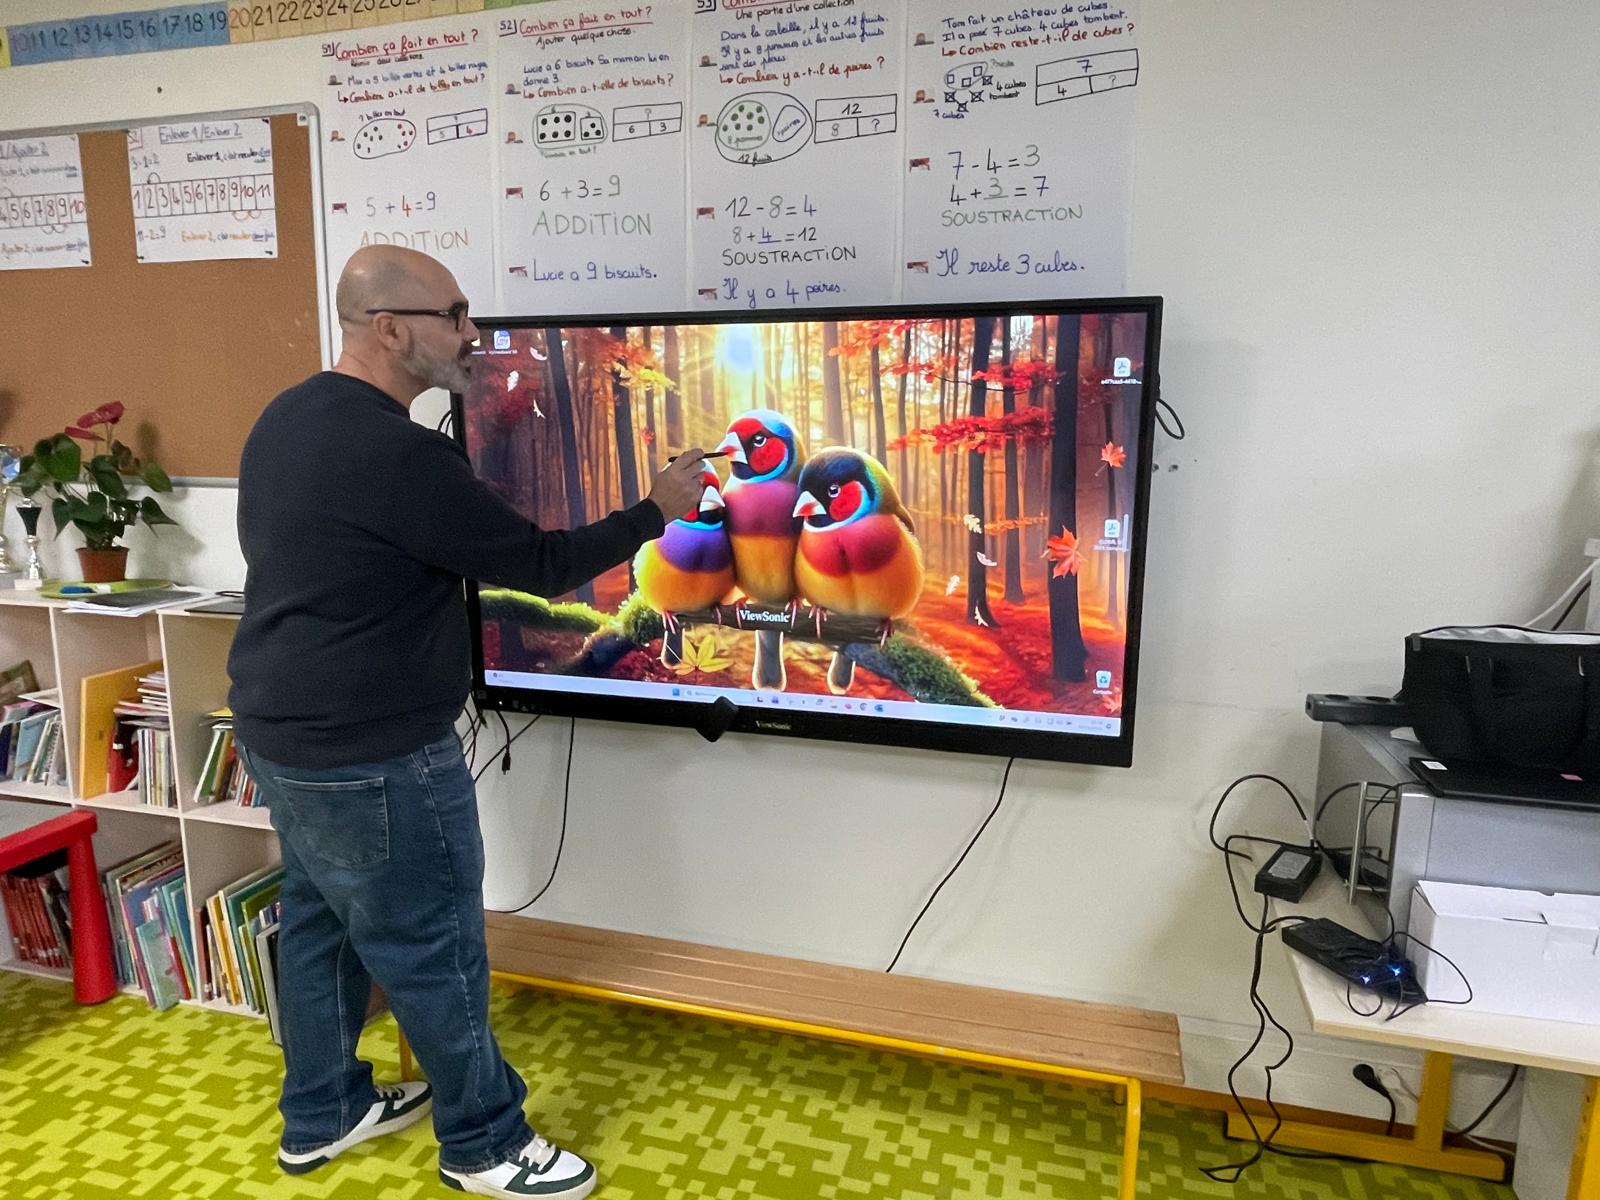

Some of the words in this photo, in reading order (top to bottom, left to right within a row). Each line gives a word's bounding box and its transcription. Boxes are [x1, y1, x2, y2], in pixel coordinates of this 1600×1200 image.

[519, 19, 559, 35] Combien
[563, 18, 575, 31] ça
[579, 12, 599, 31] fait
[604, 13, 616, 22] en
[621, 8, 642, 19] tout
[736, 9, 752, 21] Une
[757, 7, 783, 22] partie
[786, 3, 810, 15] d'une
[941, 17, 966, 29] Tom
[967, 14, 987, 28] fait
[991, 15, 1005, 24] un
[1008, 7, 1057, 22] château
[1061, 3, 1074, 15] de
[31, 30, 47, 49] 11
[53, 27, 69, 47] 12
[74, 25, 91, 44] 13
[94, 24, 113, 42] 14
[116, 20, 135, 40] 15
[139, 18, 157, 38] 16
[163, 15, 180, 36] 17
[185, 13, 204, 33] 18
[209, 10, 228, 31] 19
[229, 8, 250, 29] 20
[253, 5, 273, 26] 21
[277, 2, 299, 23] 22
[303, 0, 324, 20] 23
[327, 0, 348, 17] 24
[720, 31, 747, 42] Dans
[751, 27, 761, 38] la
[809, 17, 819, 31] il
[822, 19, 829, 32] y
[832, 19, 840, 28] a
[992, 25, 1003, 38] 7
[1039, 21, 1048, 32] 4
[1051, 17, 1079, 31] cubes
[335, 41, 379, 62] Combien
[383, 41, 396, 56] ça
[401, 34, 423, 57] fait
[427, 36, 439, 45] en
[443, 31, 466, 44] tout
[536, 36, 567, 50] Ajouter
[570, 31, 605, 44] quelque
[735, 46, 741, 61] y
[744, 46, 752, 55] a
[757, 44, 763, 55] 8
[764, 40, 800, 56] pommes
[802, 38, 814, 48] et
[830, 30, 858, 42] autres
[859, 27, 886, 44] fruits
[959, 41, 1006, 56] Combien
[1072, 28, 1088, 42] de
[1093, 26, 1123, 39] cubes
[523, 64, 543, 75] Lucie
[546, 63, 552, 72] a
[554, 59, 562, 71] 6
[598, 54, 611, 65] Sa
[612, 55, 646, 65] maman
[659, 54, 671, 62] en
[719, 60, 740, 72] sont
[743, 57, 757, 69] des
[737, 71, 779, 86] Combien
[783, 72, 791, 88] y
[828, 62, 841, 75] de
[877, 56, 886, 69] ?
[1077, 59, 1093, 73] 7
[373, 75, 379, 85] 5
[416, 84, 426, 94] de
[452, 80, 462, 88] en
[463, 76, 479, 86] tout
[523, 76, 550, 87] donne
[538, 86, 577, 99] Combien
[617, 76, 629, 88] de
[996, 80, 1003, 92] 4
[1056, 84, 1068, 97] 4
[841, 103, 863, 116] 12
[234, 122, 242, 137] 2
[466, 125, 474, 137] 4
[628, 125, 636, 134] 6
[659, 122, 668, 132] 3
[831, 123, 840, 137] 8
[133, 190, 141, 209] 1
[145, 188, 154, 209] 2
[158, 186, 169, 208] 3
[171, 187, 180, 205] 4
[184, 184, 193, 204] 5
[195, 183, 204, 201] 6
[206, 183, 216, 202] 7
[218, 182, 227, 201] 8
[230, 181, 240, 198] 9
[241, 184, 255, 199] 10
[257, 183, 271, 198] 11
[10, 203, 20, 221] 5
[23, 201, 31, 219] 6
[34, 200, 43, 218] 7
[46, 199, 56, 218] 8
[59, 197, 68, 218] 9
[533, 257, 565, 281] Lucie
[570, 272, 580, 281] a
[586, 261, 598, 280] 9
[935, 247, 960, 277] Il
[967, 253, 1011, 275] reste
[1015, 253, 1031, 275] 3
[721, 276, 739, 300] Il
[746, 287, 757, 309] y
[765, 288, 776, 299] a
[785, 279, 800, 304] 4
[739, 609, 792, 624] ViewSonic
